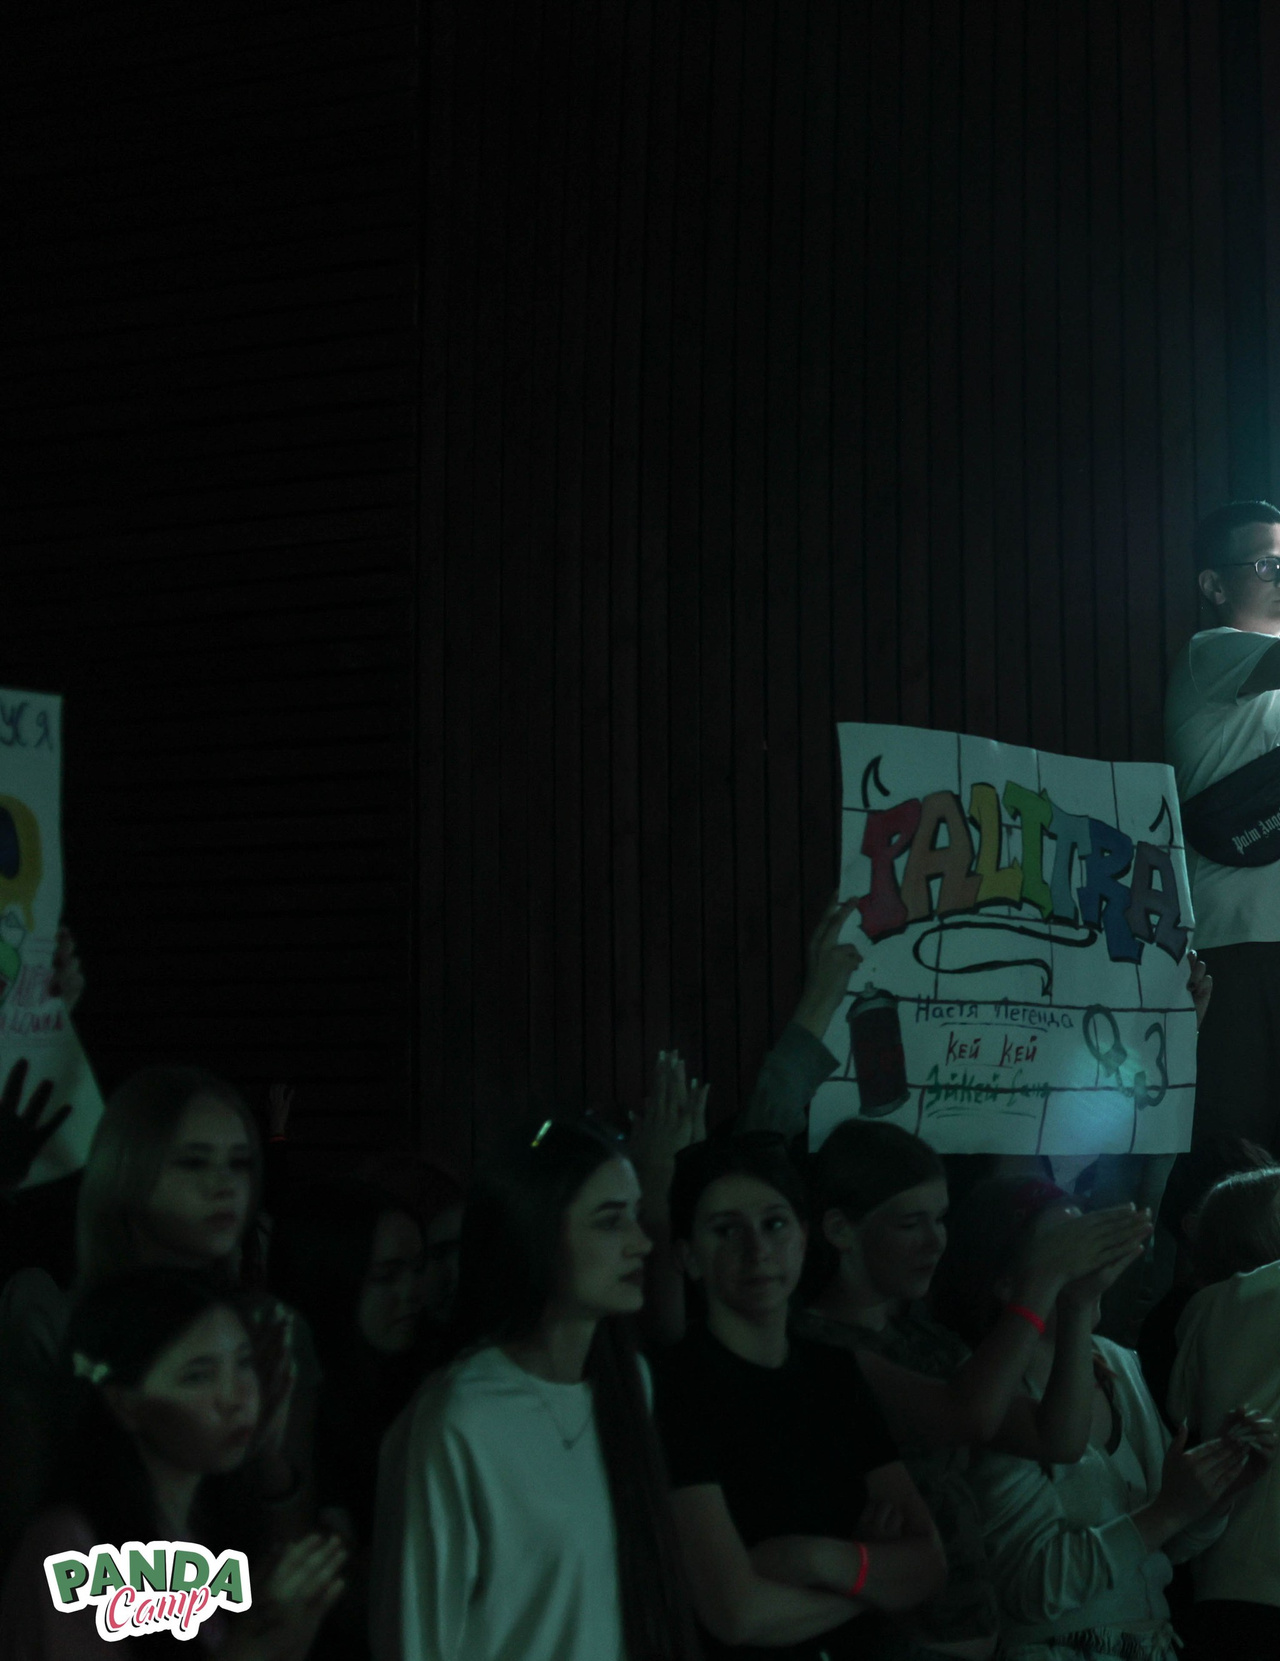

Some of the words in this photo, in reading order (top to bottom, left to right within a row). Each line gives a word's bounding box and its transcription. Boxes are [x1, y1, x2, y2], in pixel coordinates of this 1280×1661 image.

[1231, 828, 1262, 855] Palm
[857, 780, 1190, 966] PALITRA
[915, 994, 978, 1023] Настя
